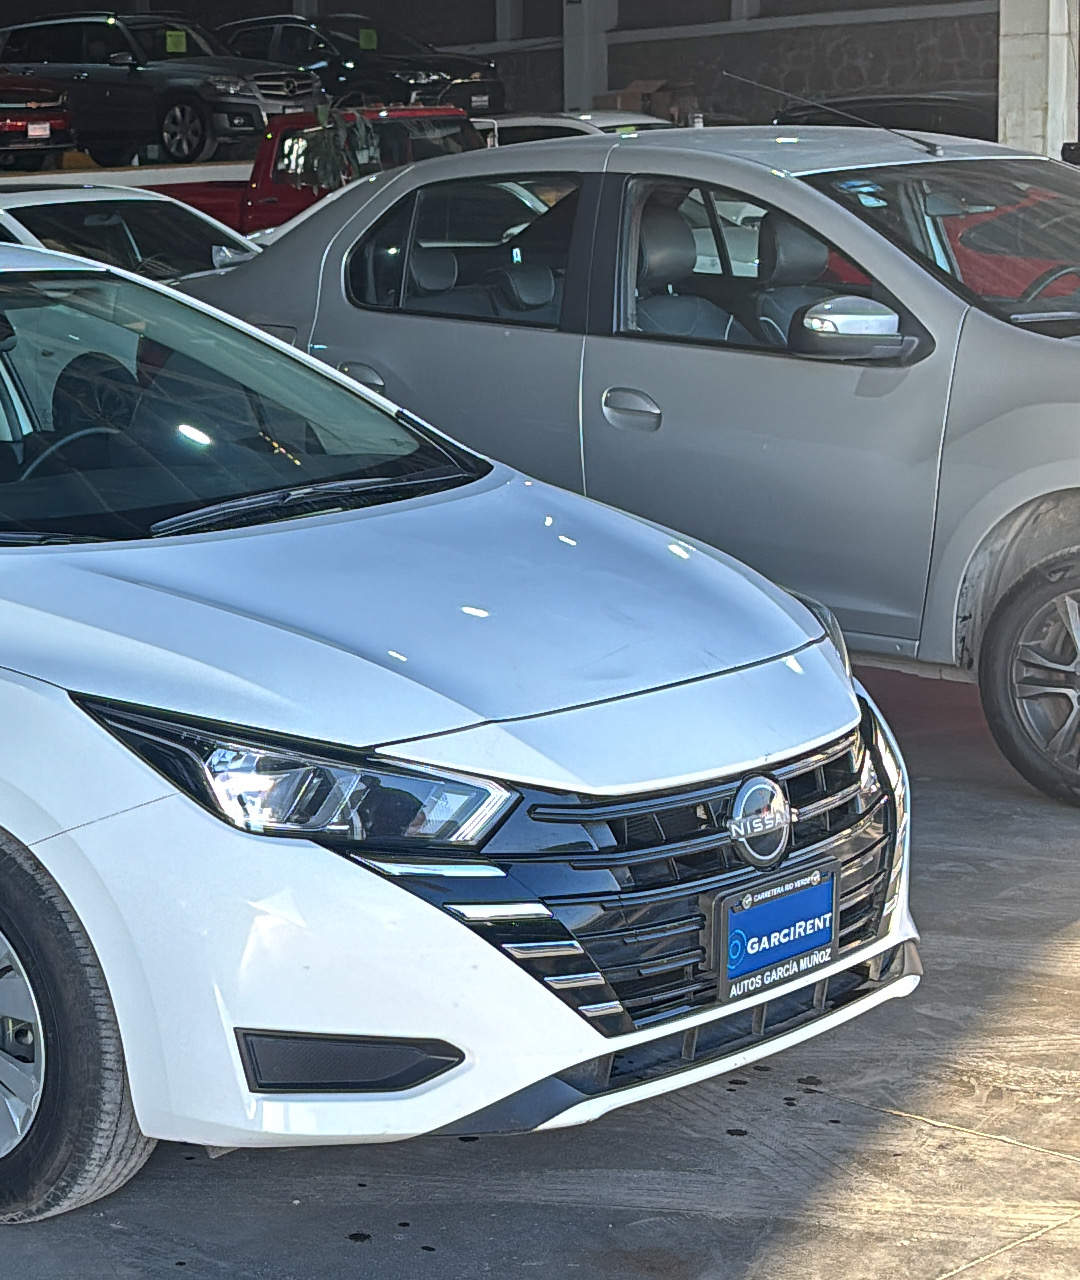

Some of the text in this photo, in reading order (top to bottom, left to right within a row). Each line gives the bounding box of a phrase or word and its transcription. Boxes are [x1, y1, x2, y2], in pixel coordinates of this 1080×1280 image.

[729, 948, 831, 998] AUTOS GARCÍA MUÑOZ
